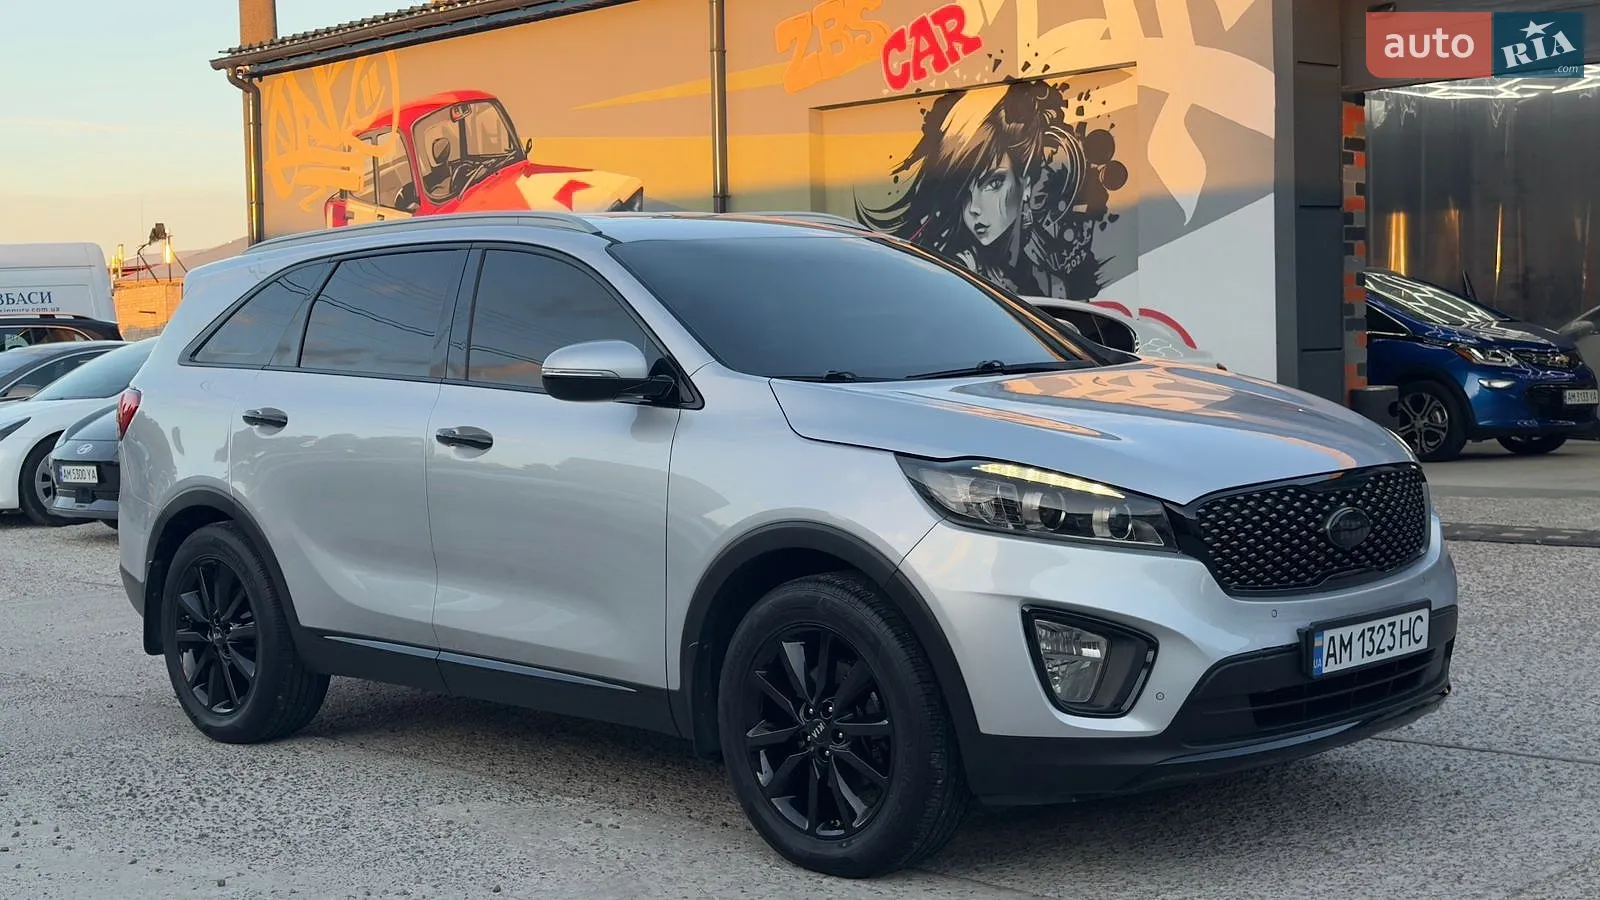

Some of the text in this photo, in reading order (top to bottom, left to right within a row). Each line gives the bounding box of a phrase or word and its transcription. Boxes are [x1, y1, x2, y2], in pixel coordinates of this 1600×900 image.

[882, 3, 983, 92] CAR
[1325, 615, 1424, 667] AM 1323 HC
[811, 723, 825, 738] KIA
